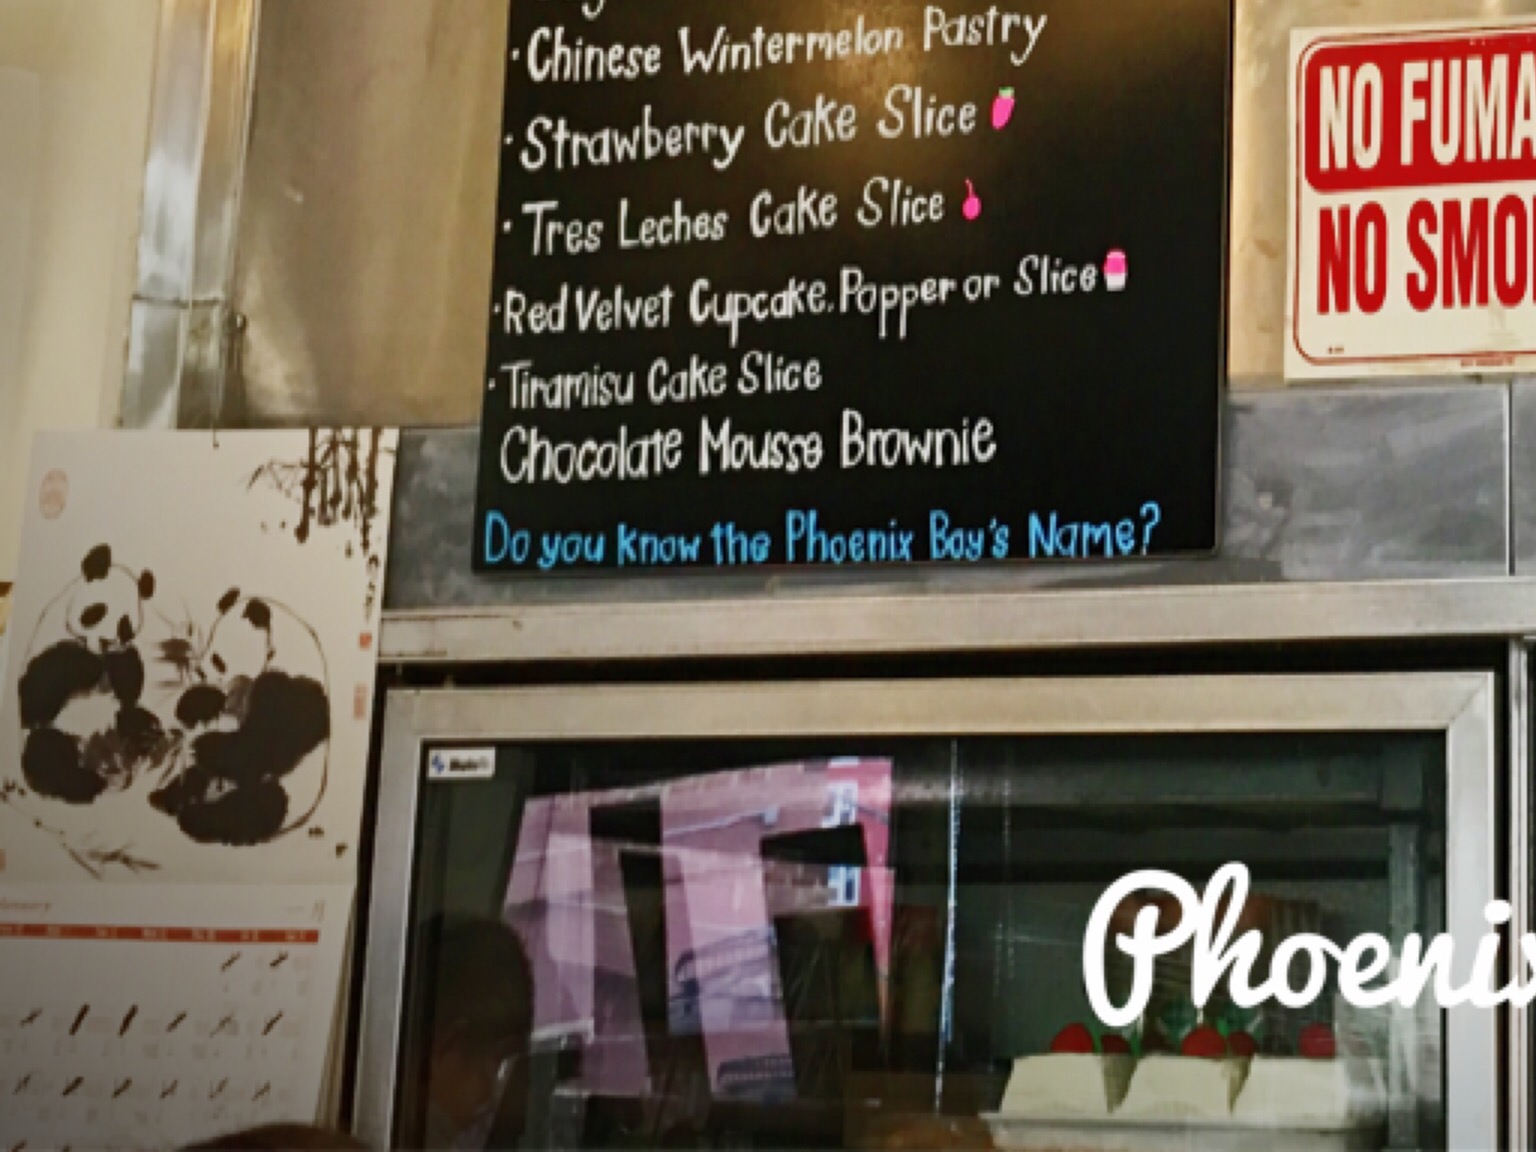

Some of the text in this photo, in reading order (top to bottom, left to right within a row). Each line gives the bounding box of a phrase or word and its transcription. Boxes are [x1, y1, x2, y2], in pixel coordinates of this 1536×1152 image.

[527, 6, 1047, 82] Chinese Wintermelon Pastry
[520, 83, 977, 171] Strawberry Cake Slice
[1319, 62, 1383, 172] NO
[523, 178, 945, 255] Tres Leches Cake Slice
[1317, 200, 1388, 315] NO
[504, 281, 569, 335] Red
[575, 283, 674, 333] Velvet
[840, 264, 956, 340] Popper
[962, 273, 1000, 302] or
[1013, 253, 1099, 296] Slice
[500, 350, 823, 410] Tiramisu Cake Slice
[500, 408, 998, 485] Chocolate Mousse Brownie
[484, 509, 532, 565] Do
[537, 530, 606, 570] you
[617, 521, 701, 568] know
[710, 521, 772, 566] the
[786, 508, 914, 565] Phoenix
[1028, 499, 1162, 559] Name?
